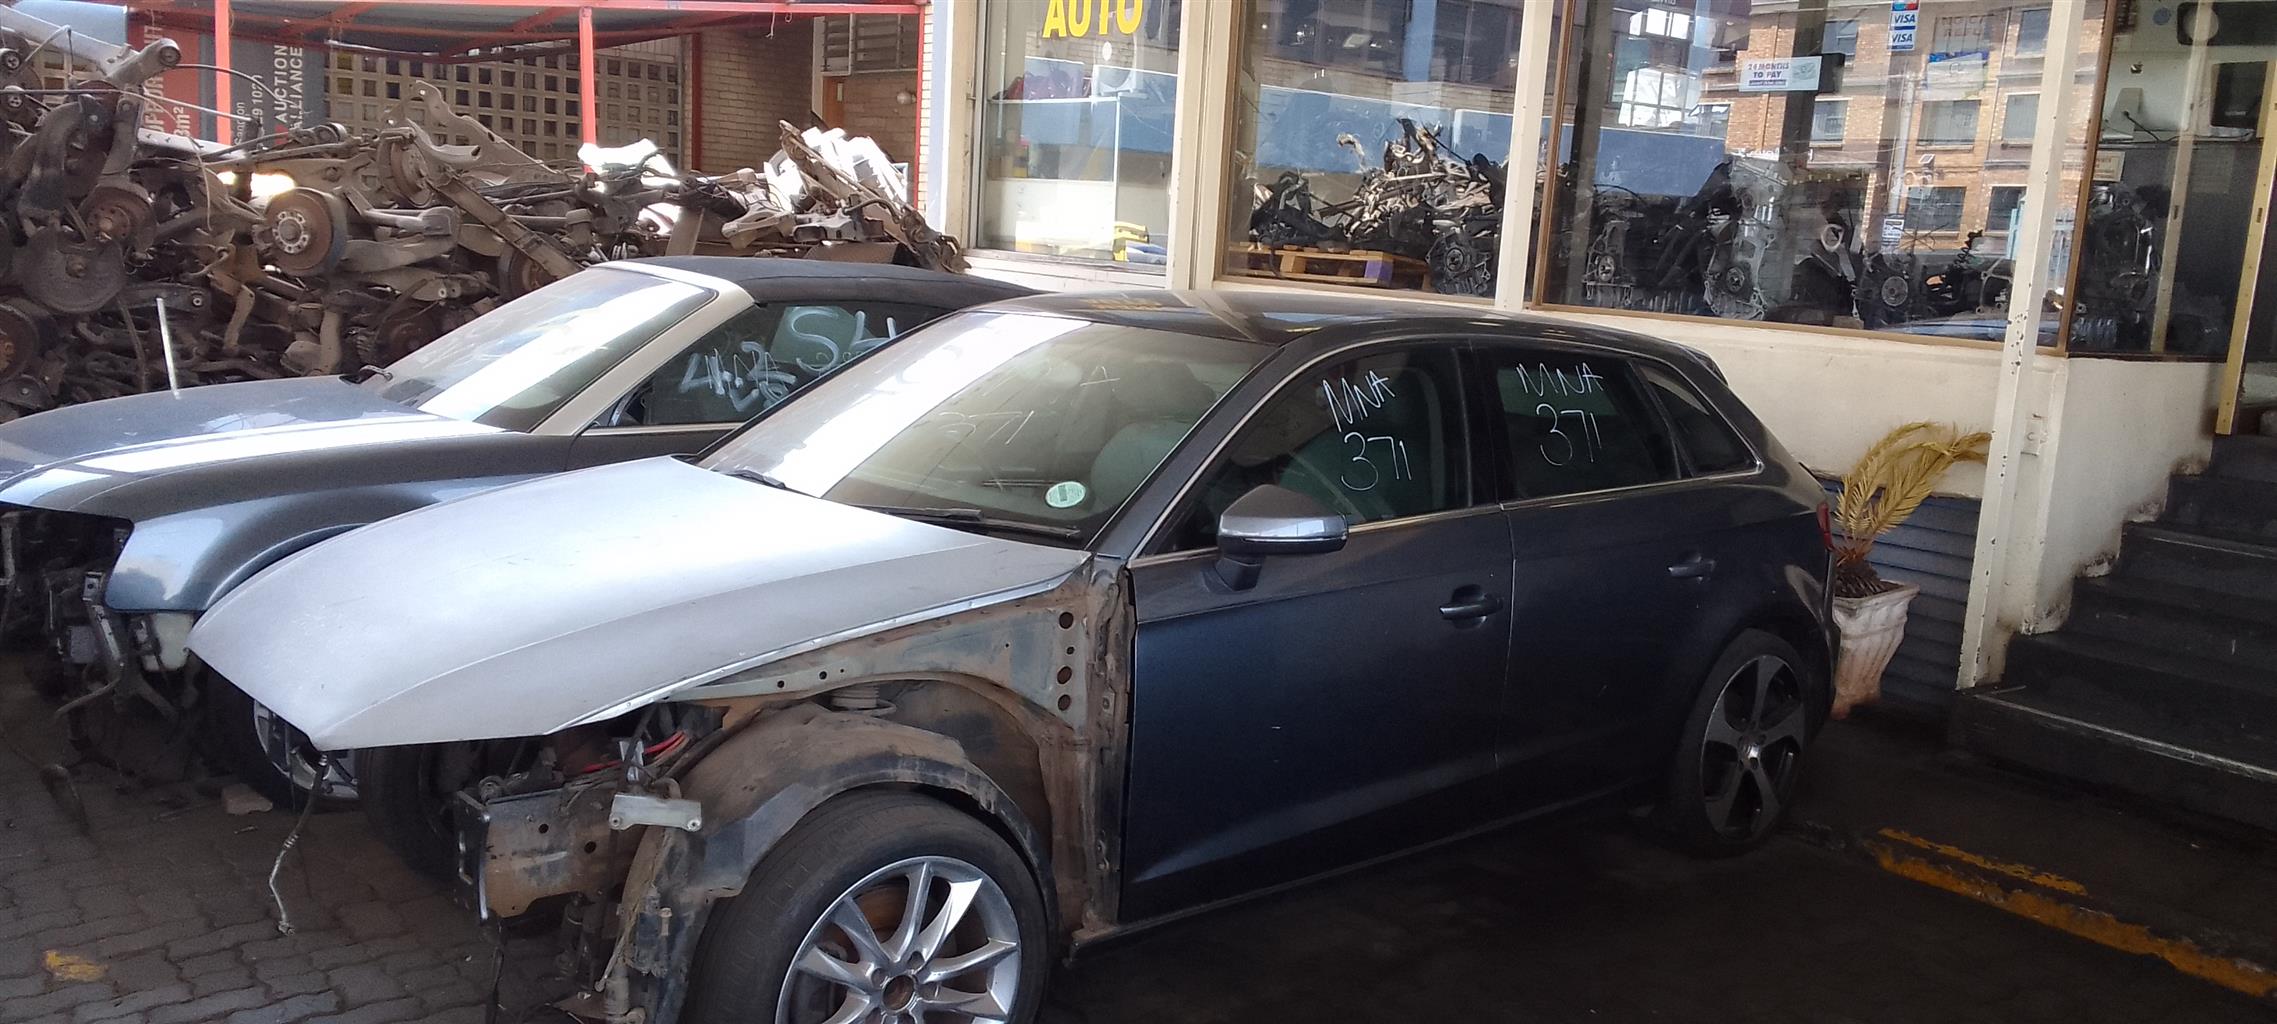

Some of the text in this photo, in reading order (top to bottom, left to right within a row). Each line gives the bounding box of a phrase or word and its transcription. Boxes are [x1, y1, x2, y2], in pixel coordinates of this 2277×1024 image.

[1892, 33, 1913, 42] VISA
[1894, 14, 1915, 23] VISA
[273, 45, 288, 123] AUCTION
[1758, 62, 1789, 70] MONTHS
[1322, 370, 1396, 433] MNA
[1516, 362, 1604, 397] MNA
[1535, 403, 1603, 466] 371
[1340, 431, 1412, 491] 371
